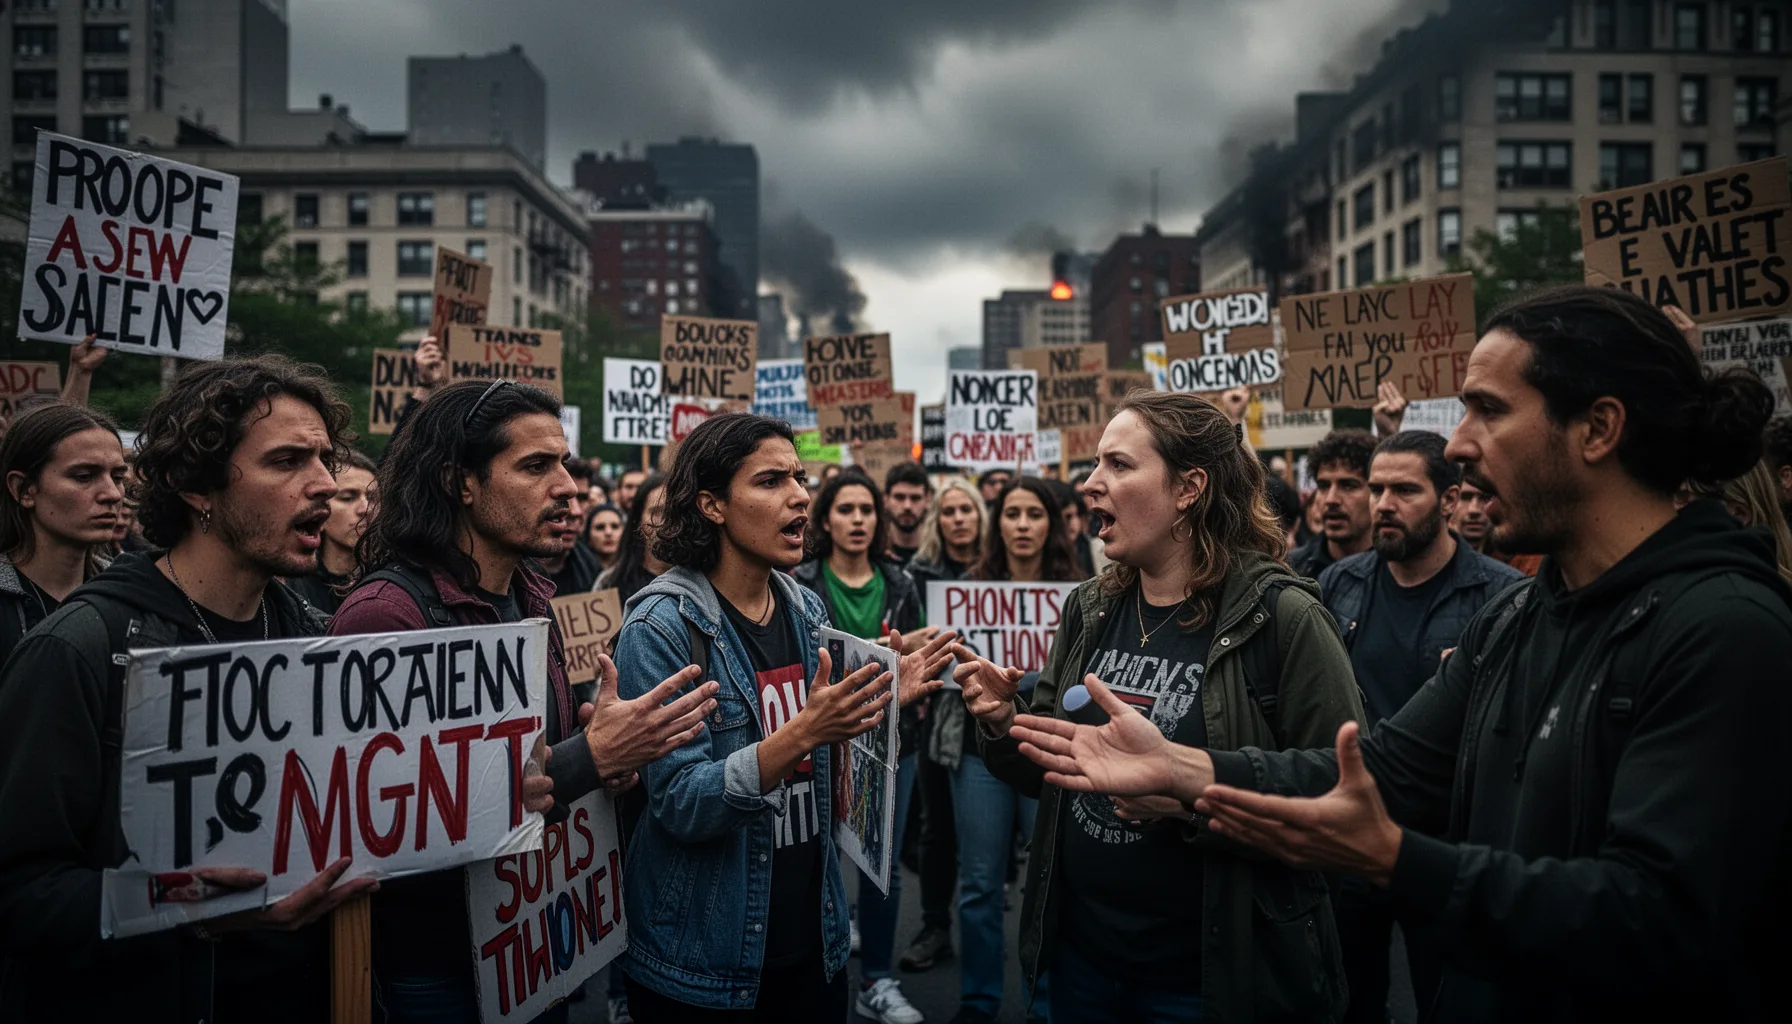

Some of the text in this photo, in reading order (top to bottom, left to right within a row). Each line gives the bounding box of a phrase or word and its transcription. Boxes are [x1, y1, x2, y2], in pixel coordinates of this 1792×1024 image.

[46, 139, 222, 240] PROOPE
[1705, 173, 1753, 216] ES
[46, 215, 192, 284] A SEW
[1620, 209, 1784, 278] E VALET
[1296, 298, 1331, 332] NE
[1409, 282, 1457, 320] LAY
[631, 365, 656, 389] DO
[974, 408, 1014, 431] LOE
